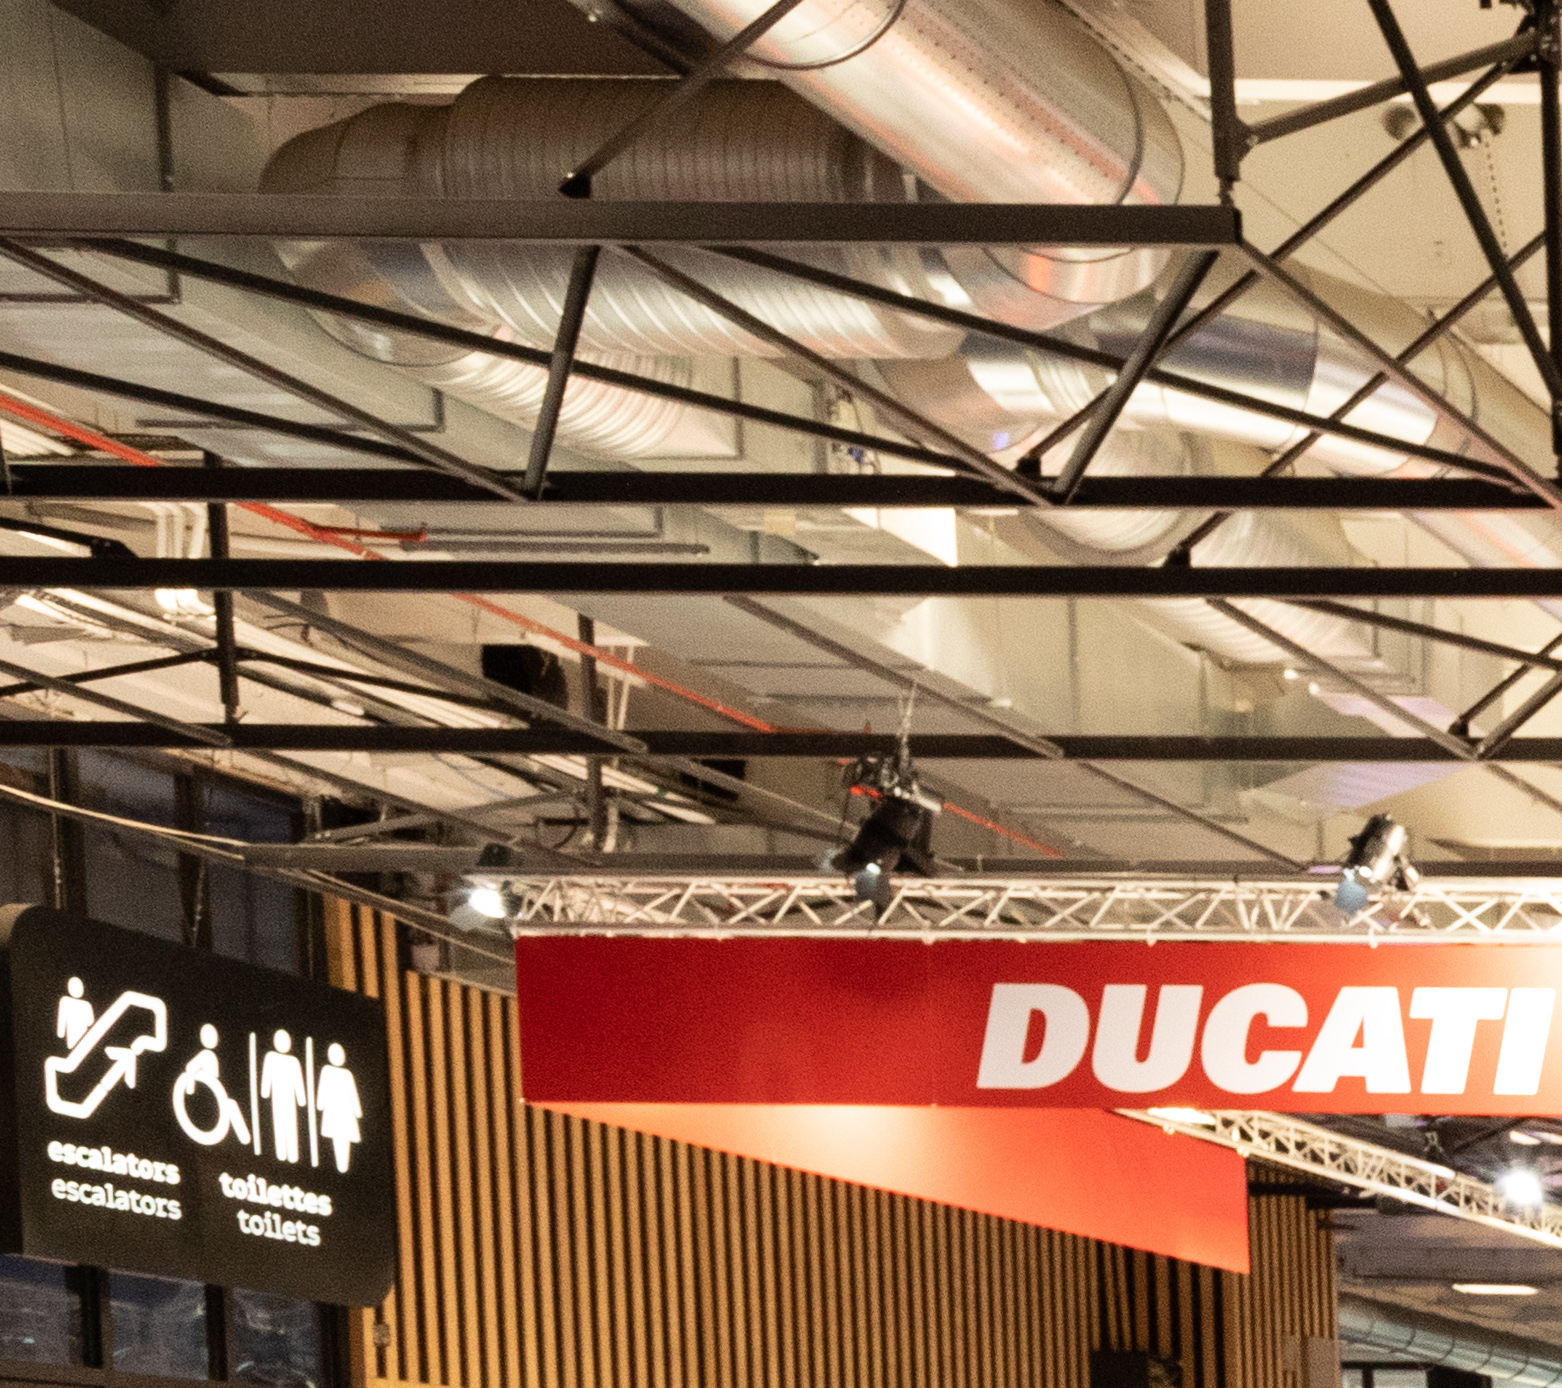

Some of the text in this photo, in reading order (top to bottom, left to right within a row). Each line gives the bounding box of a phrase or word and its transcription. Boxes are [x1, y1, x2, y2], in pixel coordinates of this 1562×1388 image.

[976, 982, 1556, 1095] DUCATI
[48, 1140, 181, 1185] escalators
[51, 1178, 182, 1220] escalators
[219, 1172, 332, 1216] toilettes
[237, 1209, 321, 1246] toilets
